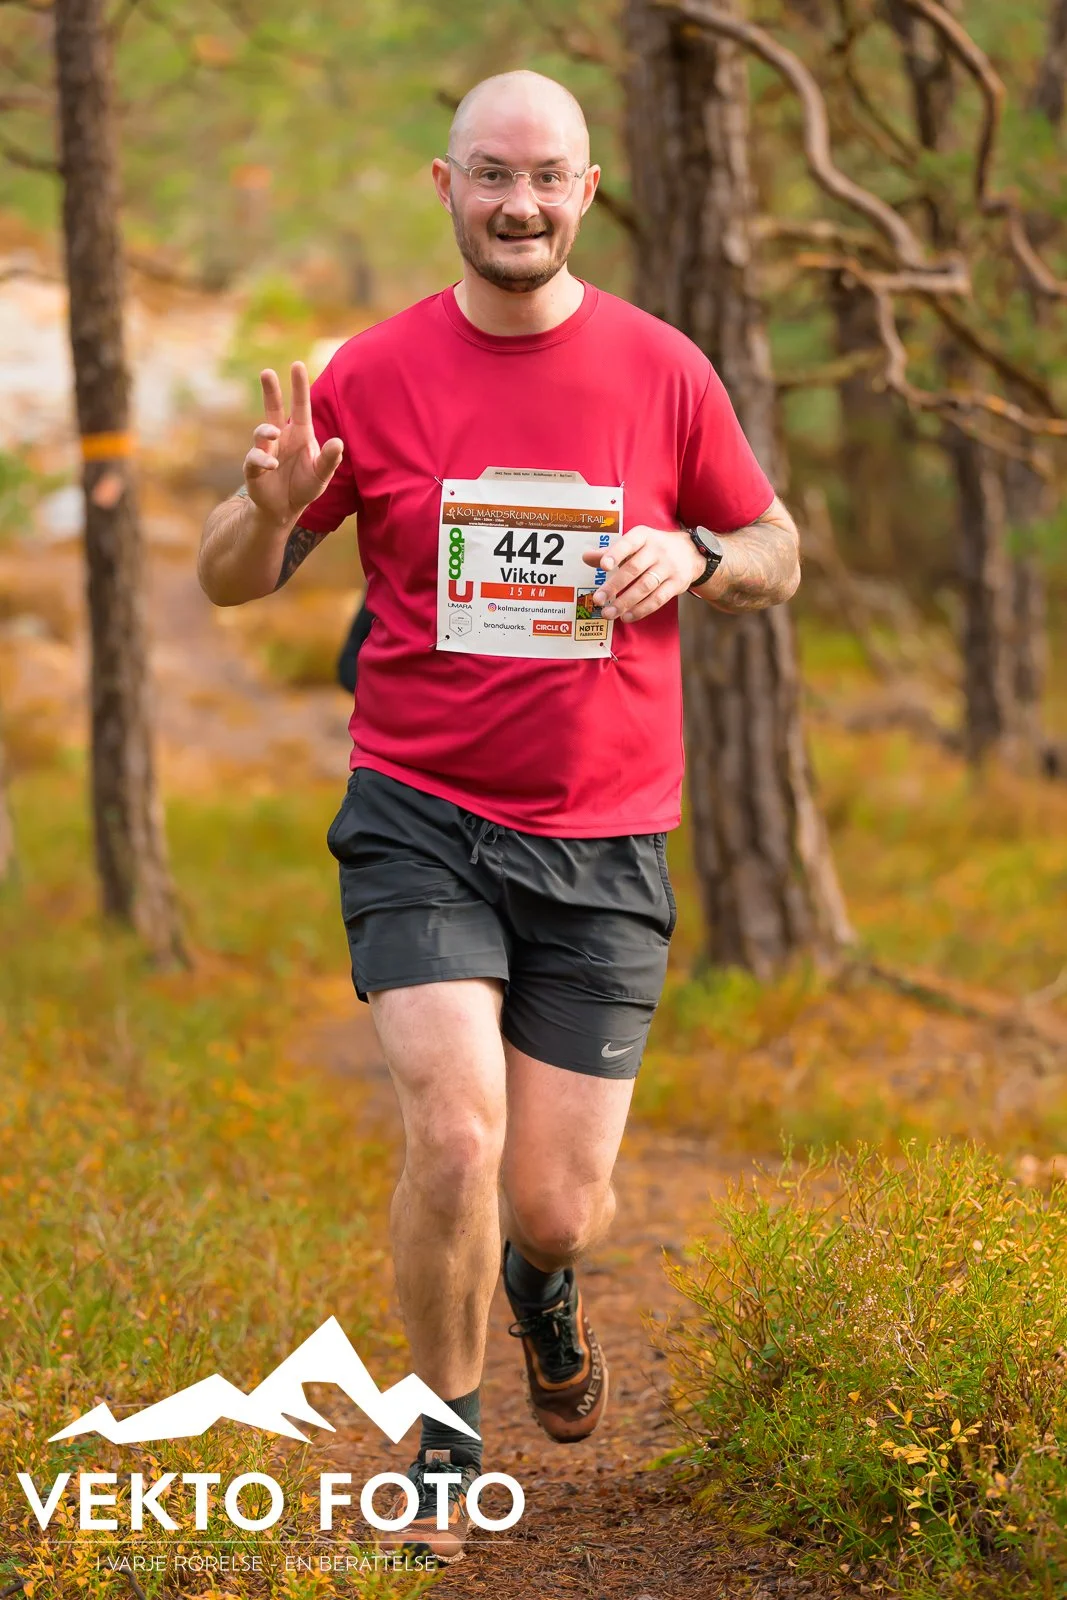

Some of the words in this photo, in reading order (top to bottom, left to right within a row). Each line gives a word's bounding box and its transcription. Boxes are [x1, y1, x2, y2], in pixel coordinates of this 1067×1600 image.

[448, 527, 465, 580] coop
[493, 530, 565, 566] 442
[500, 567, 557, 585] Viktor
[509, 587, 523, 596] 15
[530, 587, 546, 598] KM
[497, 603, 566, 614] kolmardsrundantrail
[535, 624, 559, 632] CIRCLE
[561, 624, 569, 632] K
